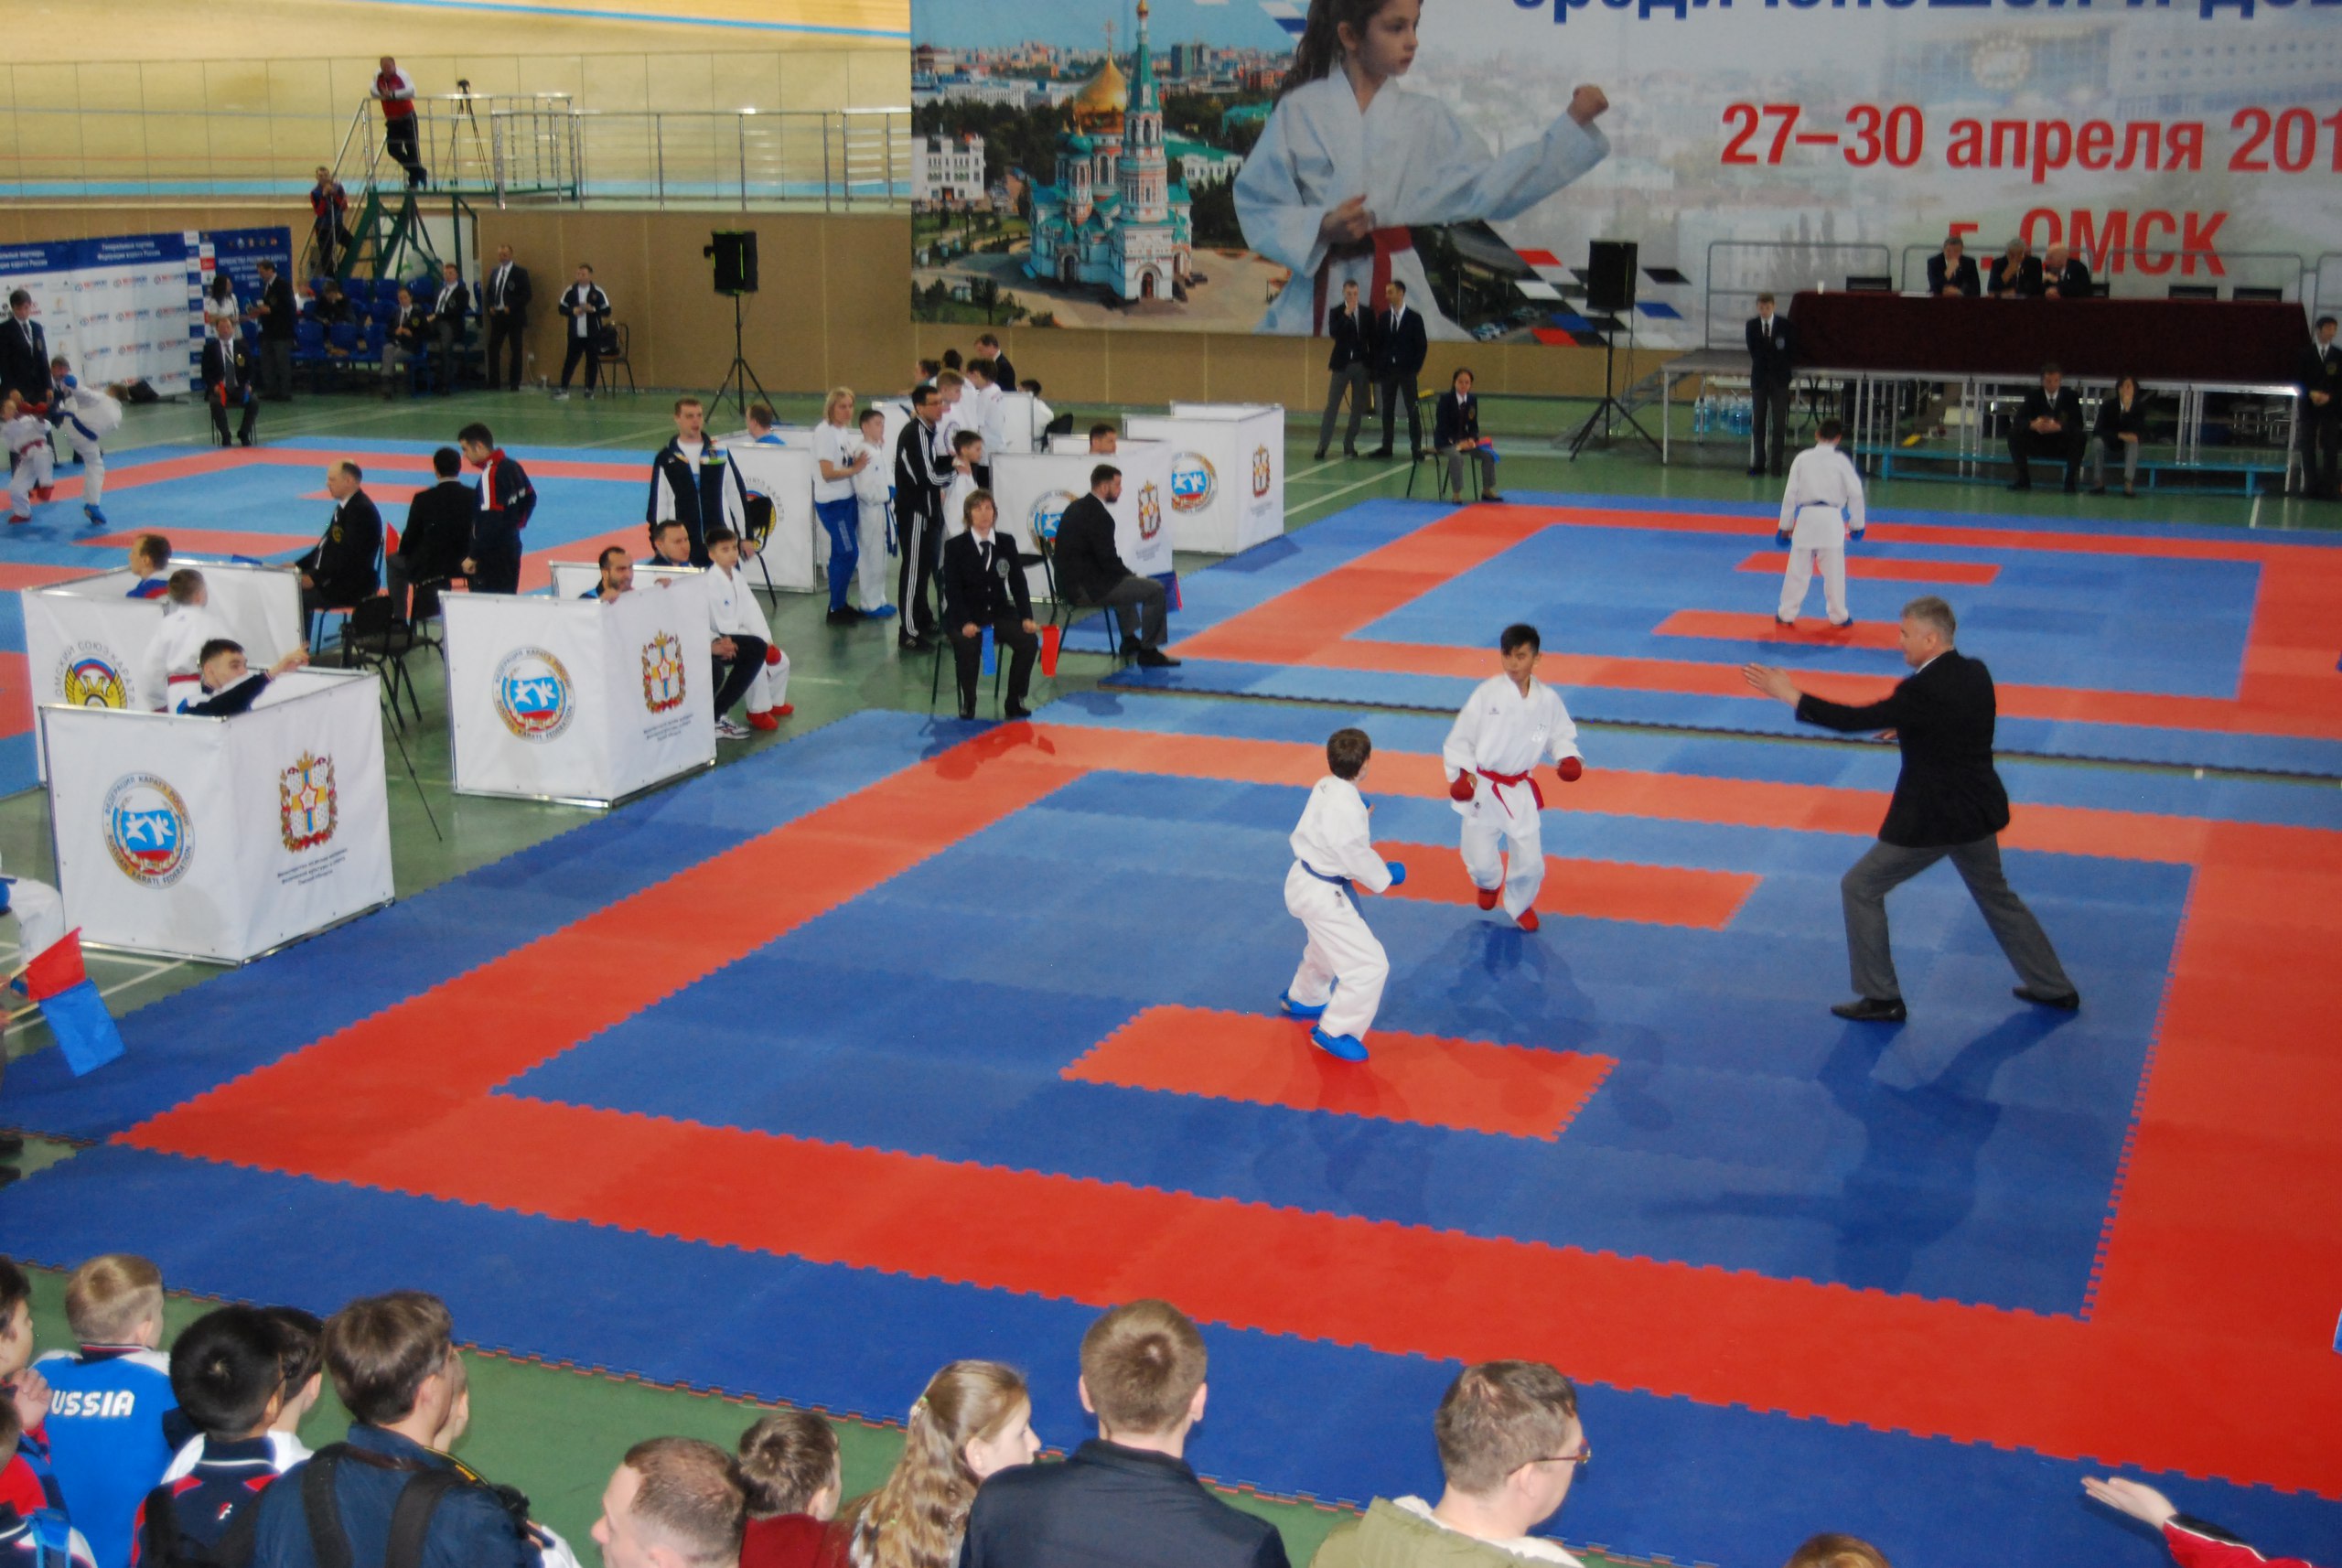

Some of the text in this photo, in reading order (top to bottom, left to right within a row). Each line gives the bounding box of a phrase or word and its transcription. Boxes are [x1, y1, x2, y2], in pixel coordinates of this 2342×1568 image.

[1946, 117, 2204, 185] апреля
[2229, 106, 2342, 174] 201
[2019, 207, 2229, 277] ОМСК
[138, 775, 167, 791] КАРАТЭ
[51, 1389, 135, 1416] USSIA
